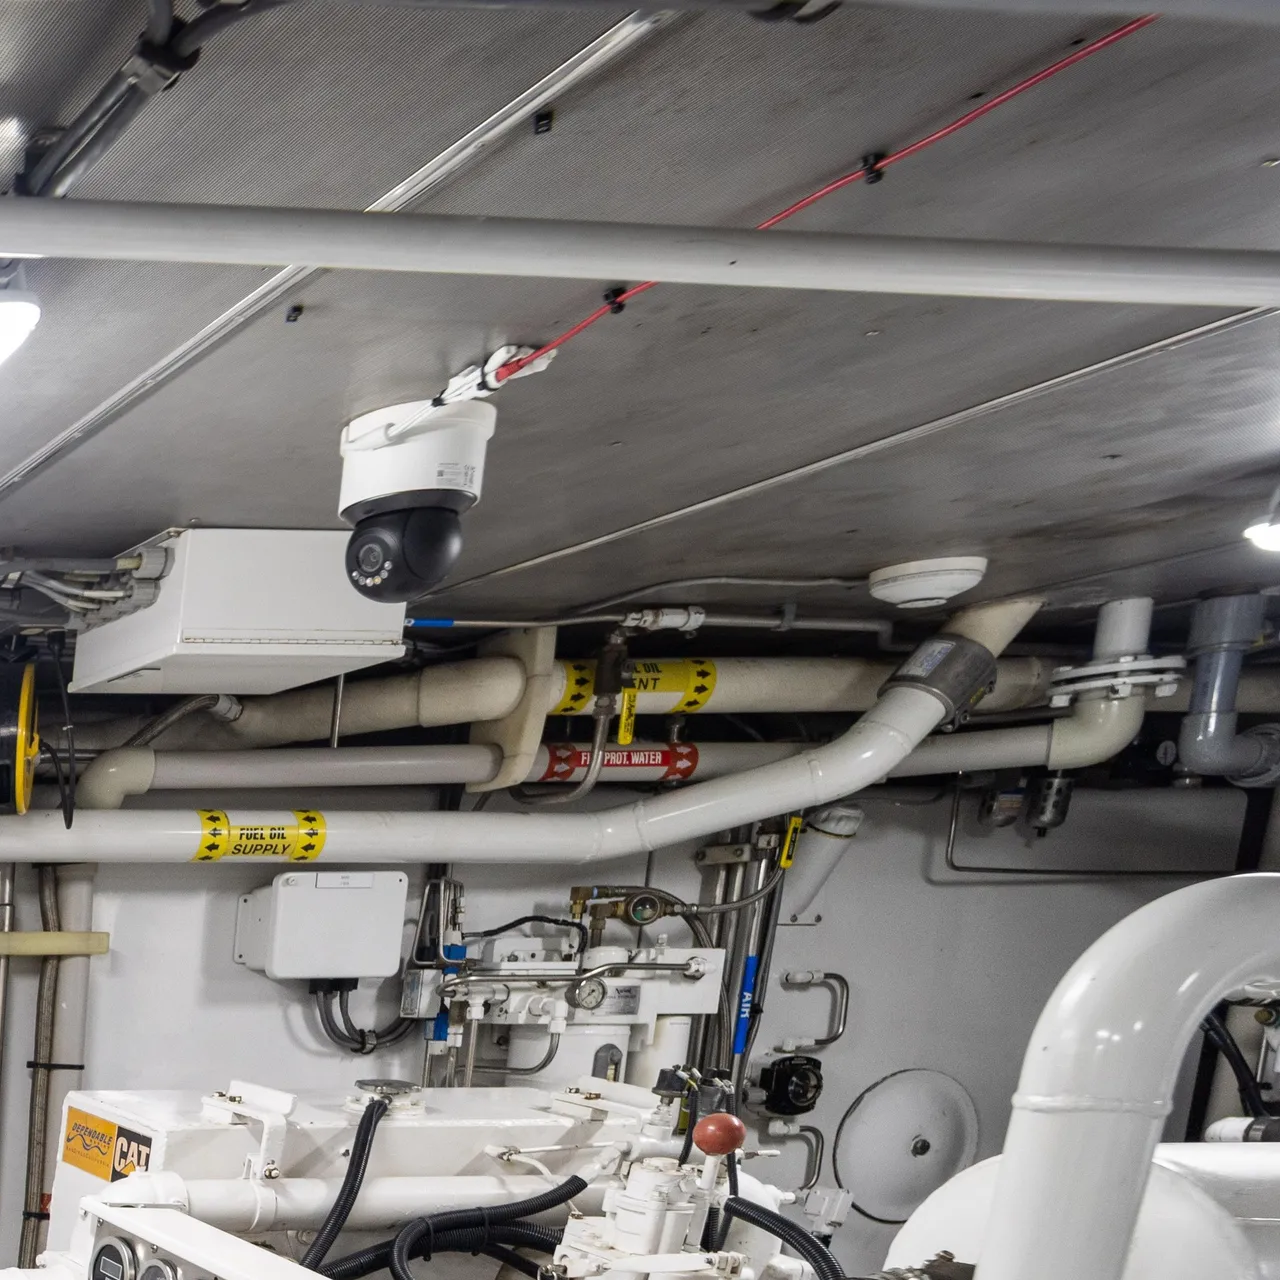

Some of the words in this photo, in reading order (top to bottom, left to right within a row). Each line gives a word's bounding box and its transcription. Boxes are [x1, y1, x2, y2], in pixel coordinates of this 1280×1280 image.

[603, 751, 629, 766] PROT.
[630, 750, 663, 766] WATER
[239, 827, 266, 841] FUEL
[269, 826, 287, 840] OIL
[231, 843, 291, 856] SUPPLY
[740, 991, 753, 1019] AIR
[71, 1122, 113, 1146] DEPENDABLE
[113, 1136, 151, 1172] CAT
